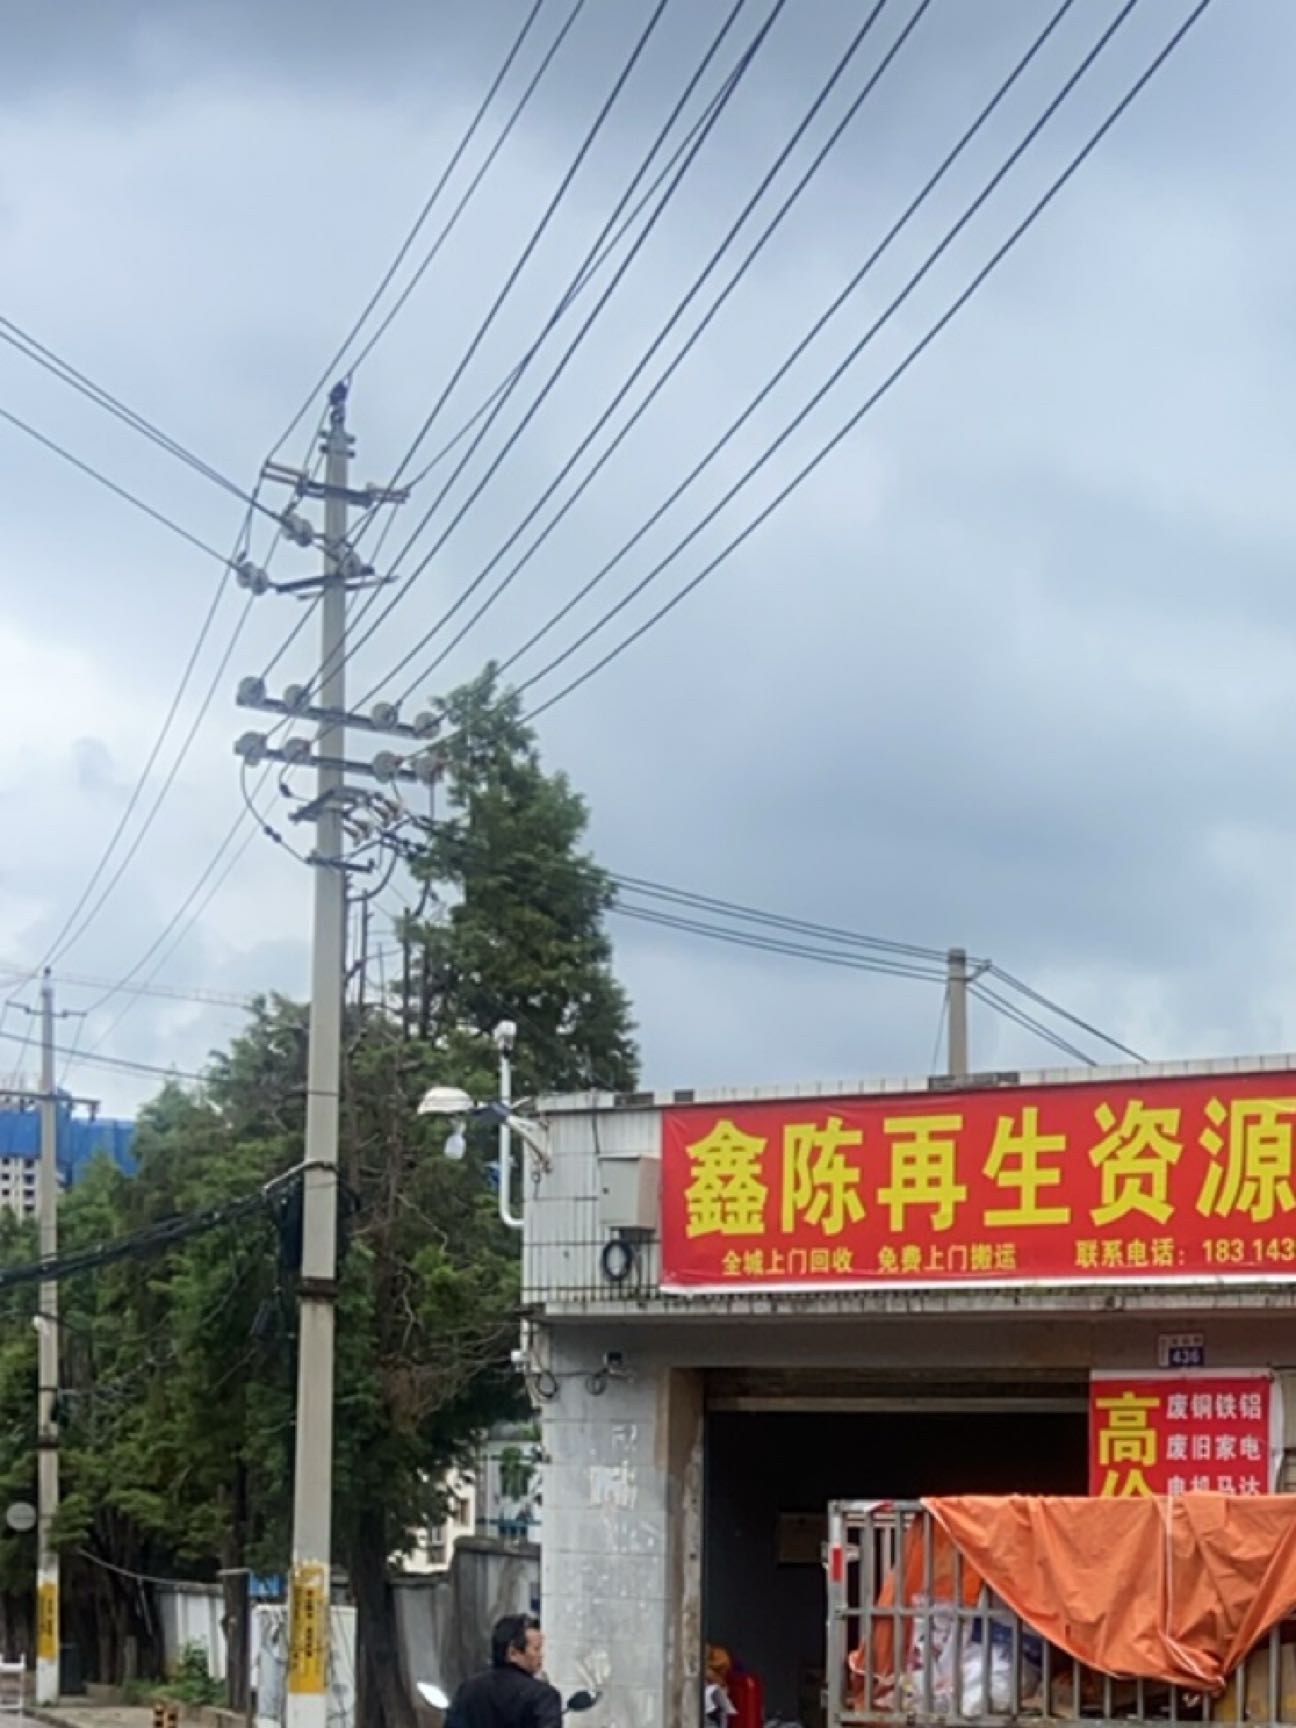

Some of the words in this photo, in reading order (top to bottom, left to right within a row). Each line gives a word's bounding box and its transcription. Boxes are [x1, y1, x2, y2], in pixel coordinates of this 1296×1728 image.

[721, 1246, 855, 1277] 全城上门回收
[877, 1242, 1018, 1273] 免费上门搬运
[1202, 1238, 1245, 1263] 183
[1166, 1391, 1262, 1420] 废铜铁铝
[1166, 1433, 1262, 1461] 废旧家电
